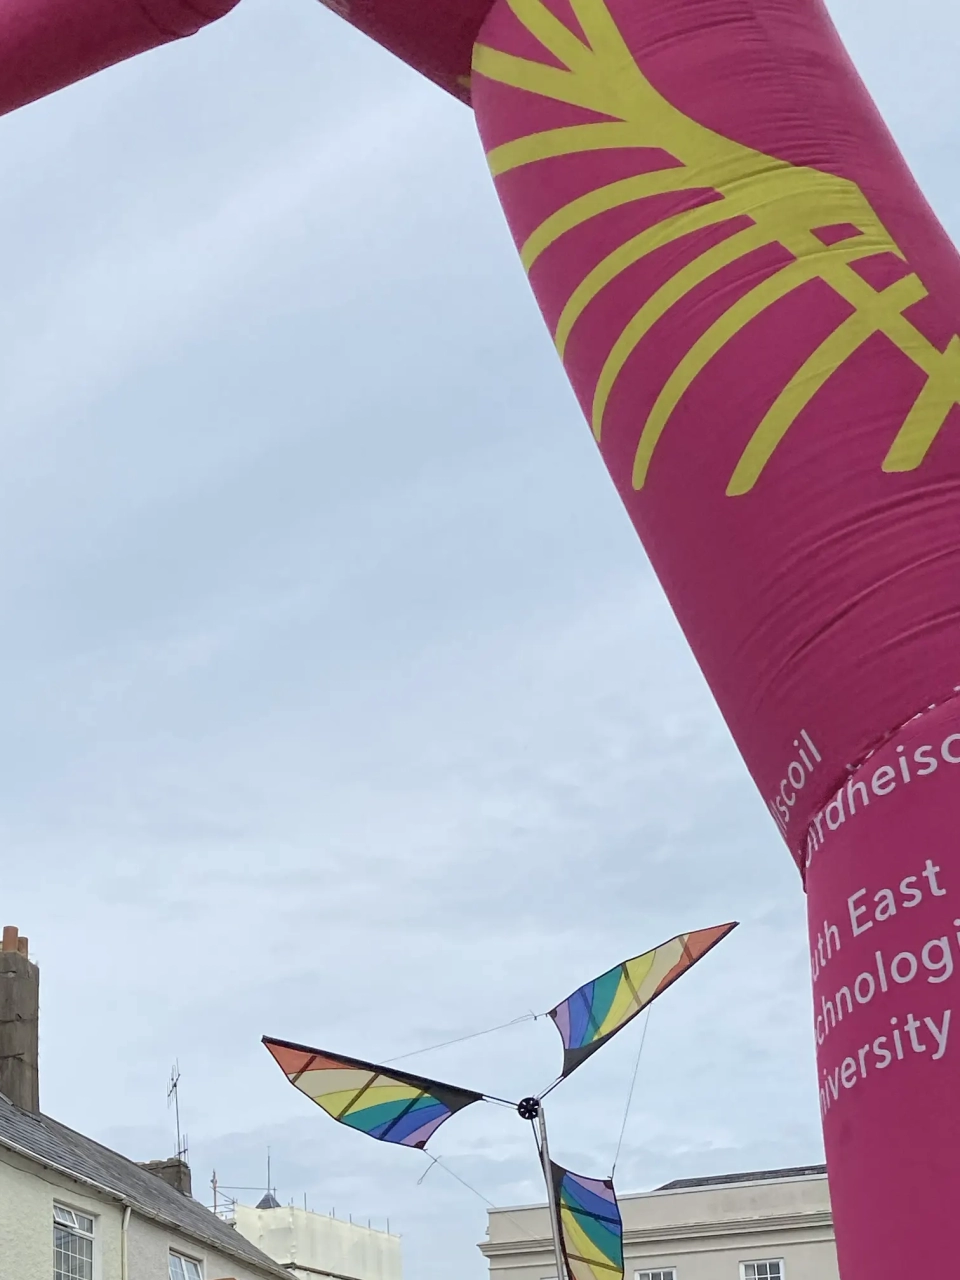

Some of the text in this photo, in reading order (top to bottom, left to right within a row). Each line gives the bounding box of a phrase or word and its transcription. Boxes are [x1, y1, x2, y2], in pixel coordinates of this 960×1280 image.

[811, 858, 948, 983] uth East
[819, 1009, 953, 1121] niversity
